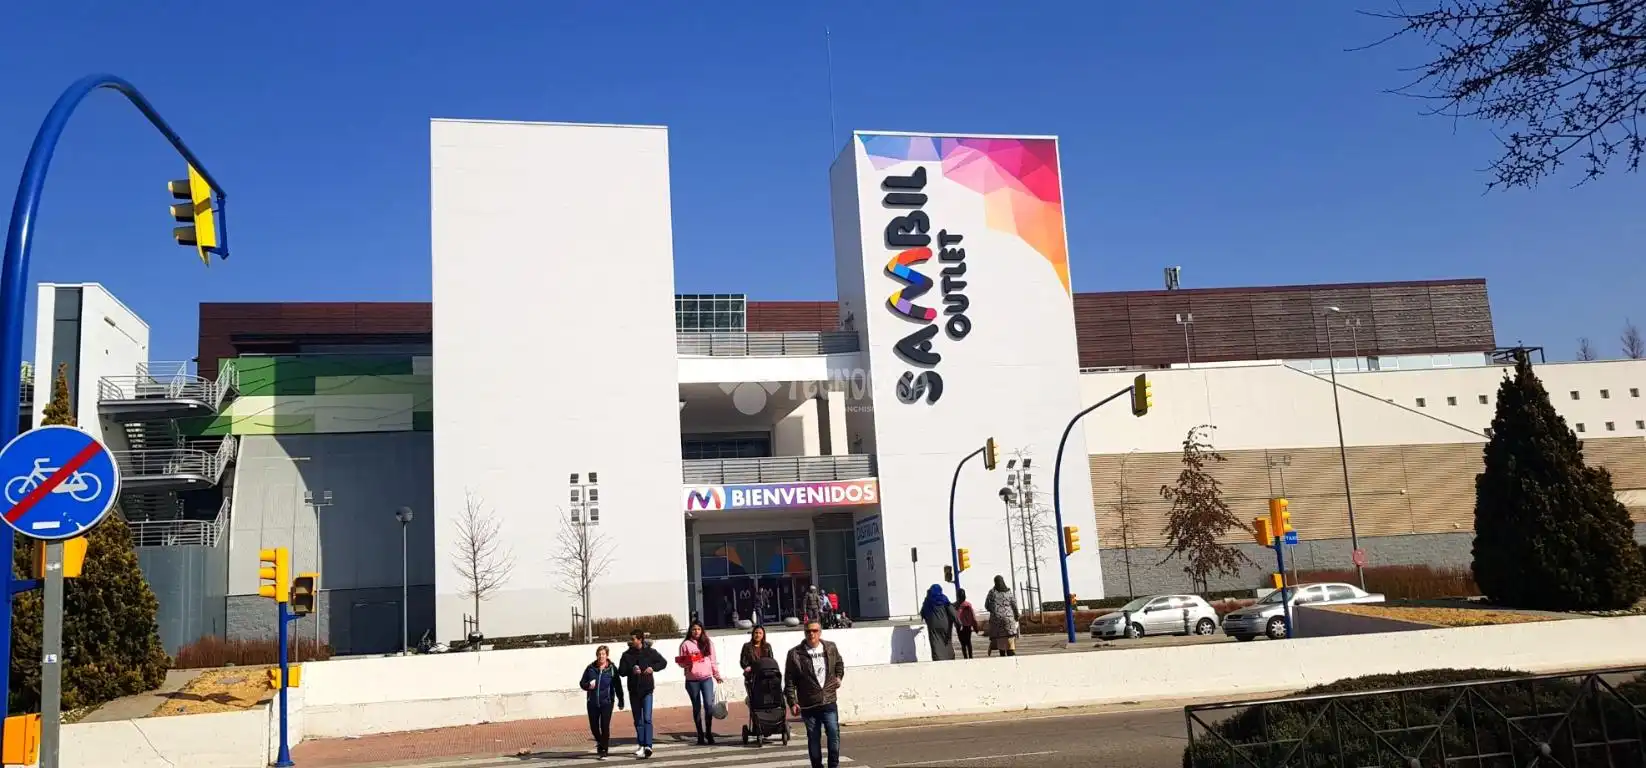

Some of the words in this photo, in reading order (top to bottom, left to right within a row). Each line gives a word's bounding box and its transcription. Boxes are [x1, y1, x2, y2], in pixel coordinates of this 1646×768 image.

[881, 165, 943, 406] SAMBIL
[937, 228, 972, 341] OUTLET
[732, 484, 876, 507] BIENVENIDOS
